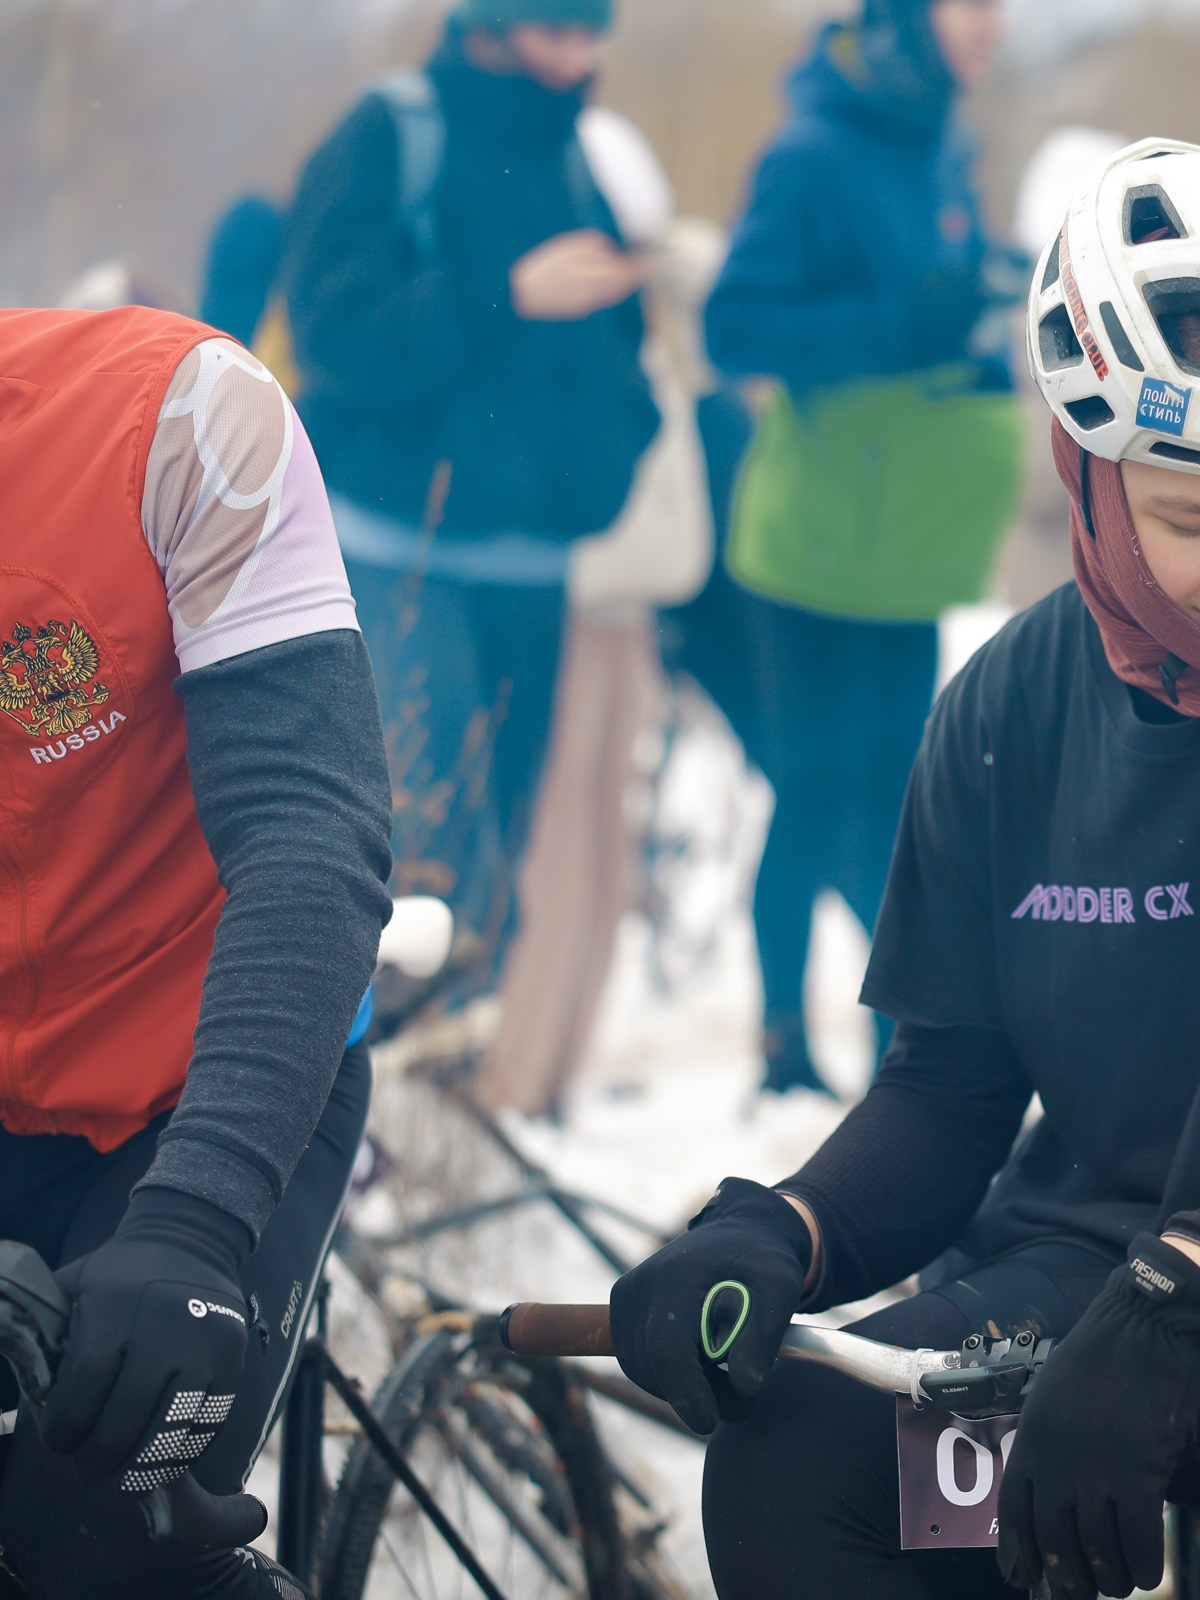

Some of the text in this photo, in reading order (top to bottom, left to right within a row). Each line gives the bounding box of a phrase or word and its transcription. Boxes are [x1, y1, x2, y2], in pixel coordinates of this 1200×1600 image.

[1081, 331, 1109, 382] CLUB
[29, 710, 127, 765] RUSSIA
[1010, 883, 1136, 924] MODDER
[1144, 881, 1195, 921] CX
[1130, 1258, 1175, 1294] FASHION
[280, 1287, 299, 1339] CRAFT
